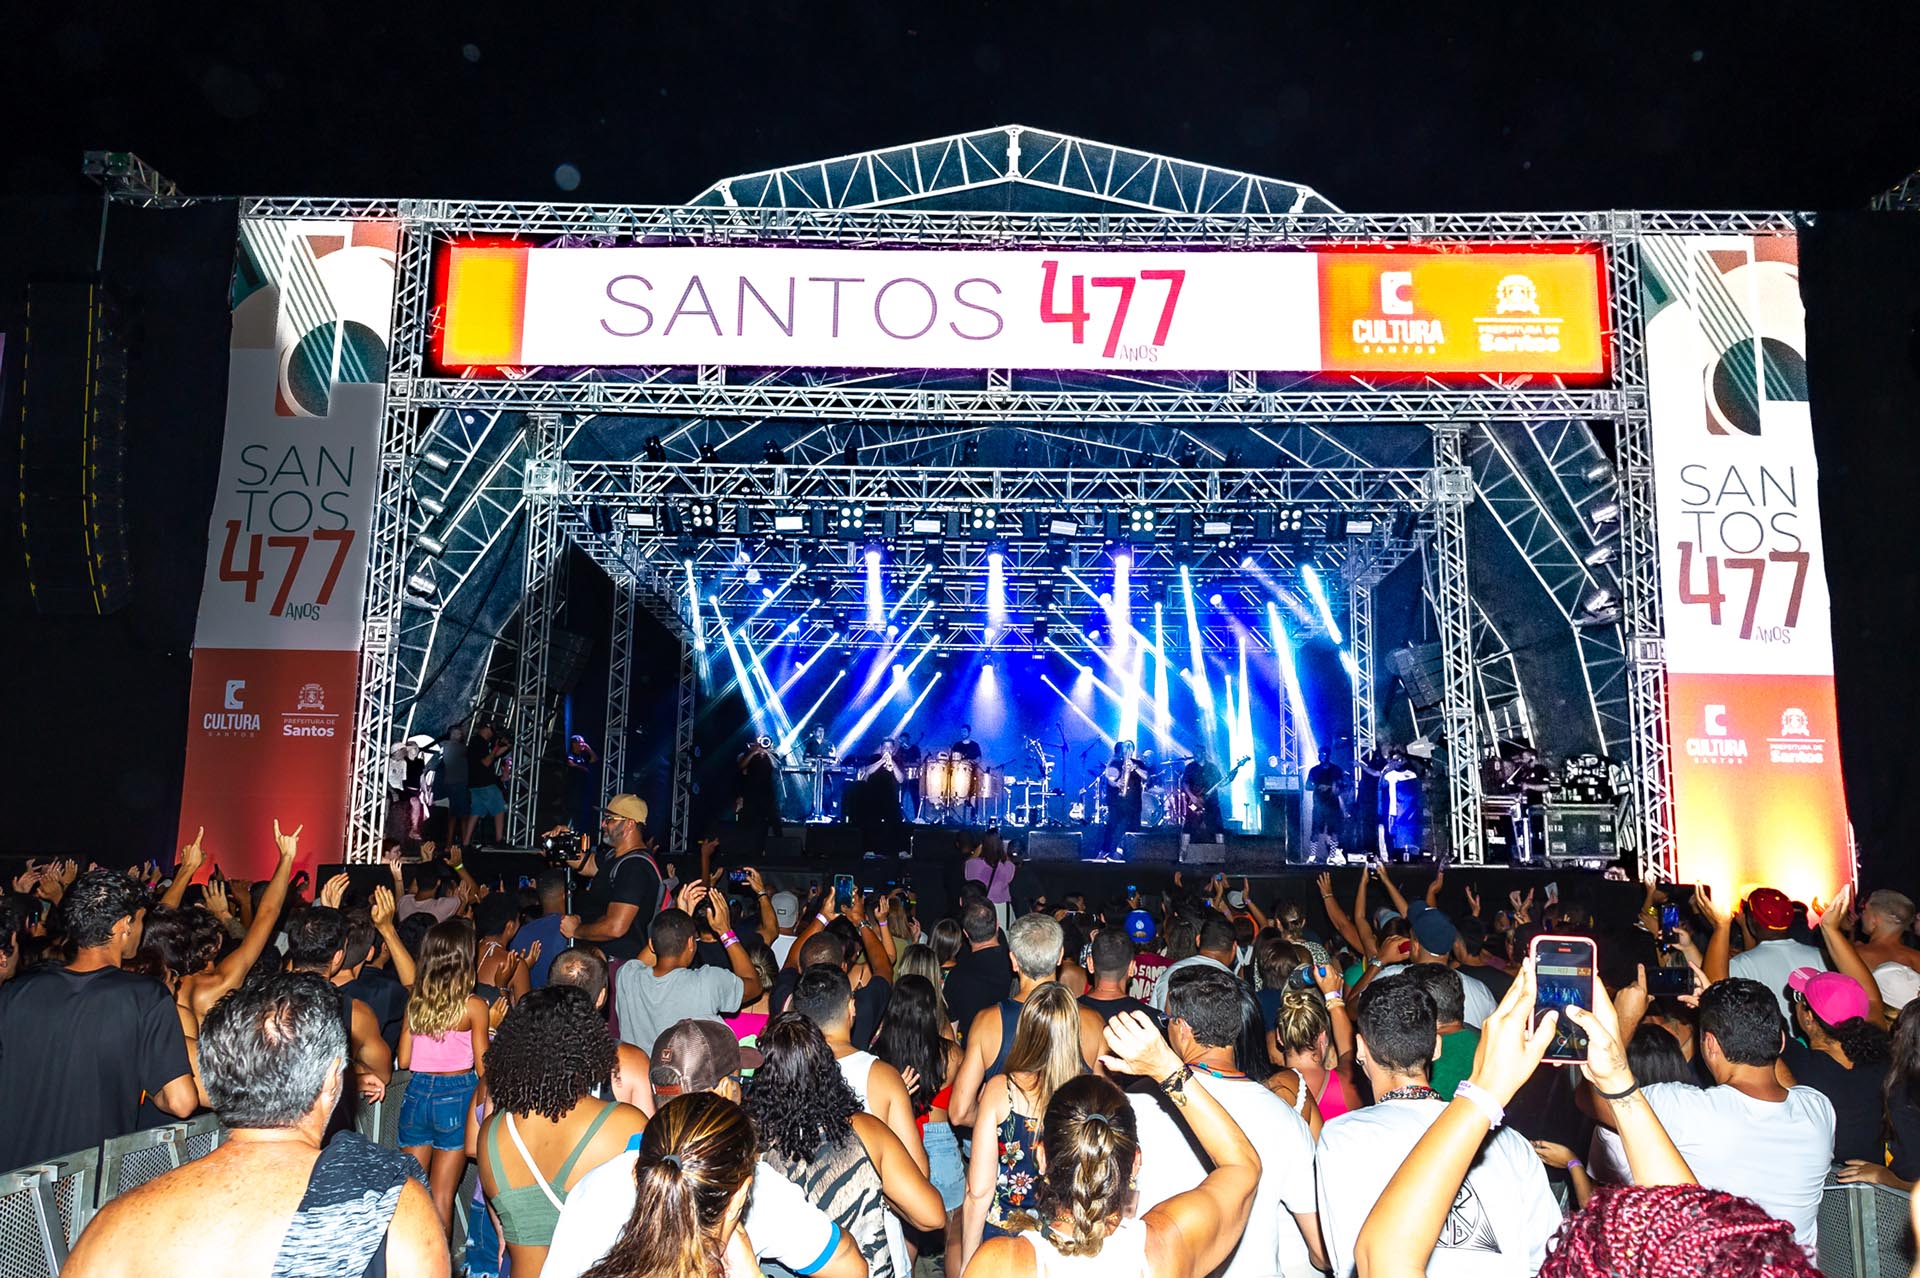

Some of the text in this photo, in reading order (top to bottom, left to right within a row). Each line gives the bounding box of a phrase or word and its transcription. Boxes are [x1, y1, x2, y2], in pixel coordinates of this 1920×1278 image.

[600, 260, 1185, 358] SANTOS 477
[1352, 319, 1445, 344] CULTURA
[1479, 333, 1561, 352] Santos
[1119, 344, 1158, 362] ANOS
[237, 444, 355, 487] SAN
[1680, 464, 1797, 508] SAN
[235, 490, 349, 533] TOS
[1681, 511, 1802, 554] TOS
[219, 519, 355, 617] 477
[1677, 541, 1810, 640] 477
[285, 602, 321, 621] ANOS
[1755, 626, 1791, 645] ANOS
[203, 713, 260, 731] CULTURA
[283, 724, 335, 737] Santos
[1686, 738, 1748, 757] CULTURA
[1770, 750, 1824, 763] Santos
